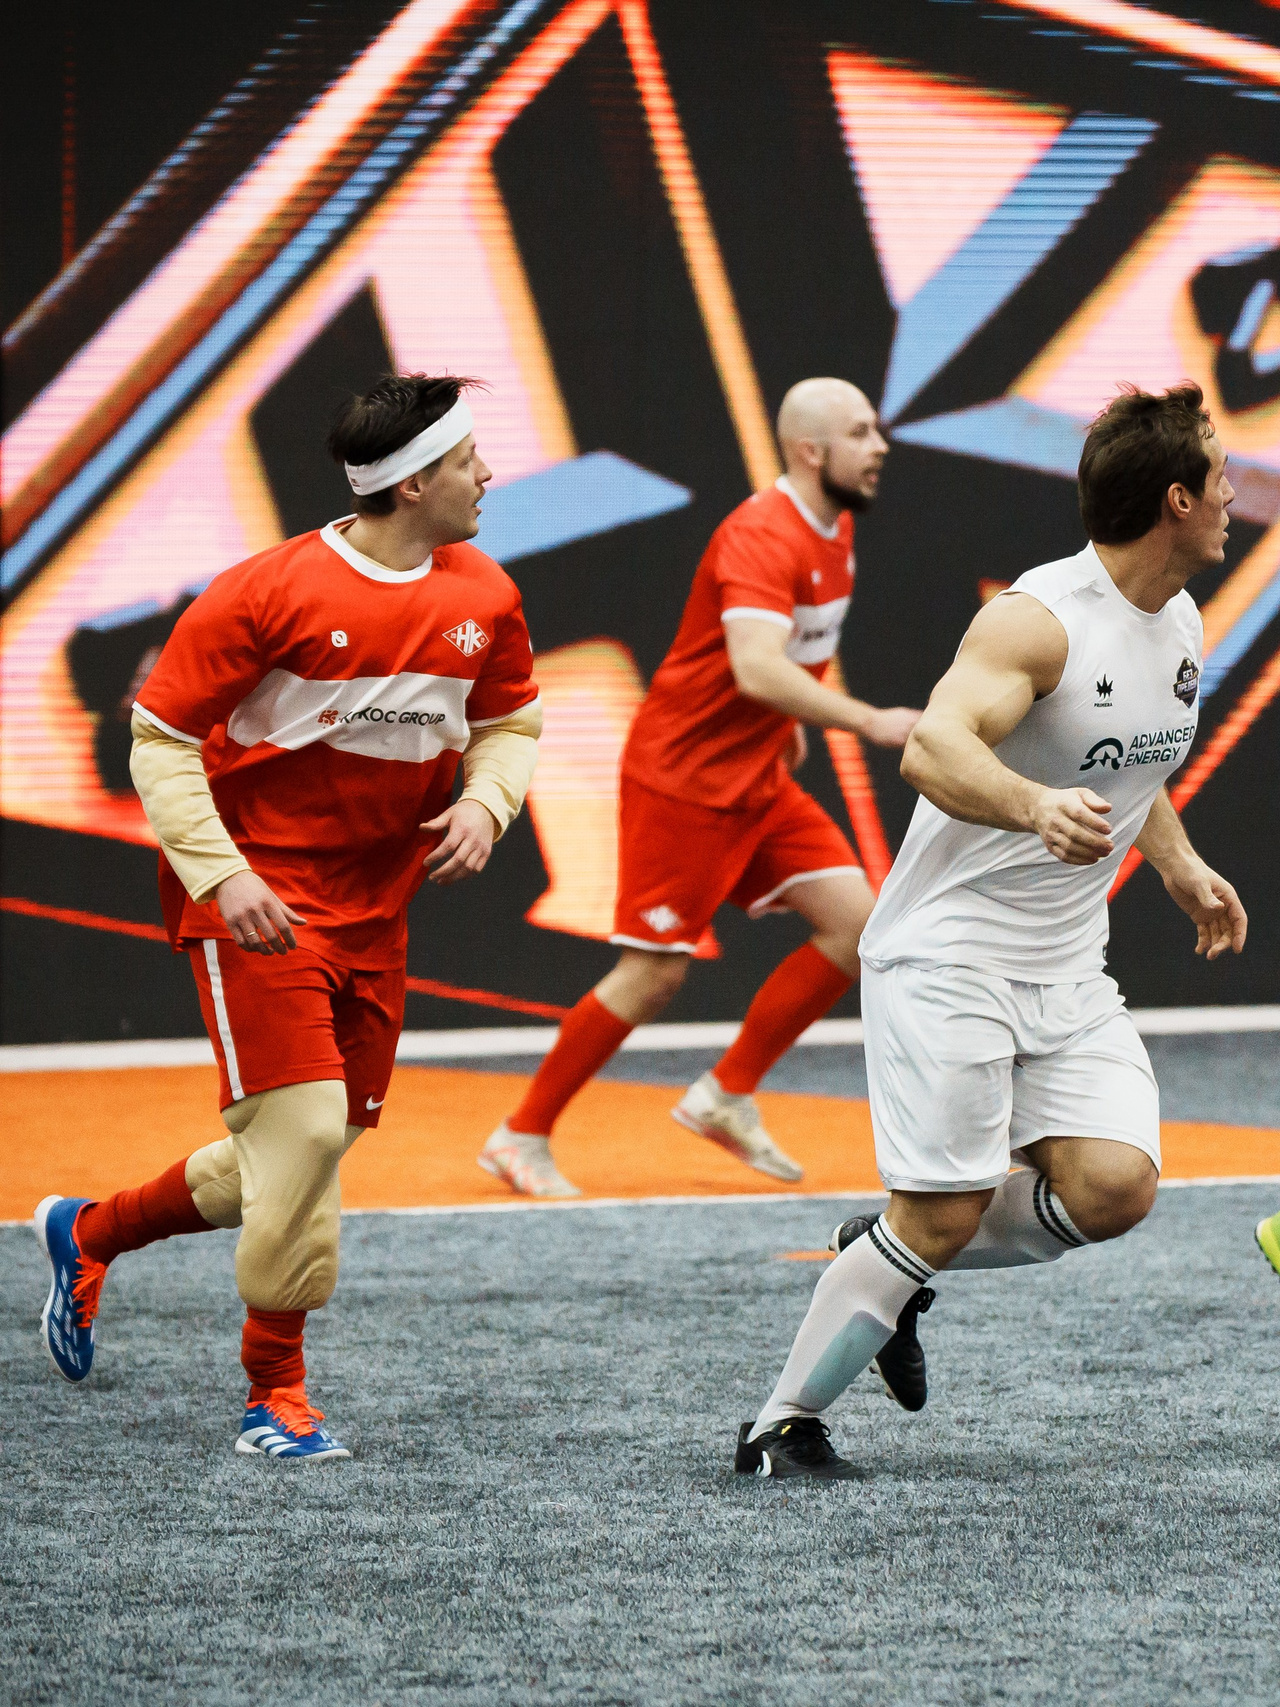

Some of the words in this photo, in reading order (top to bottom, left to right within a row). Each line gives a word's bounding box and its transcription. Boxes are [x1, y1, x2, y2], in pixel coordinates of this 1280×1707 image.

[398, 711, 446, 726] GROUP
[1128, 725, 1196, 751] ADVANCED
[1123, 746, 1181, 768] ENERGY
